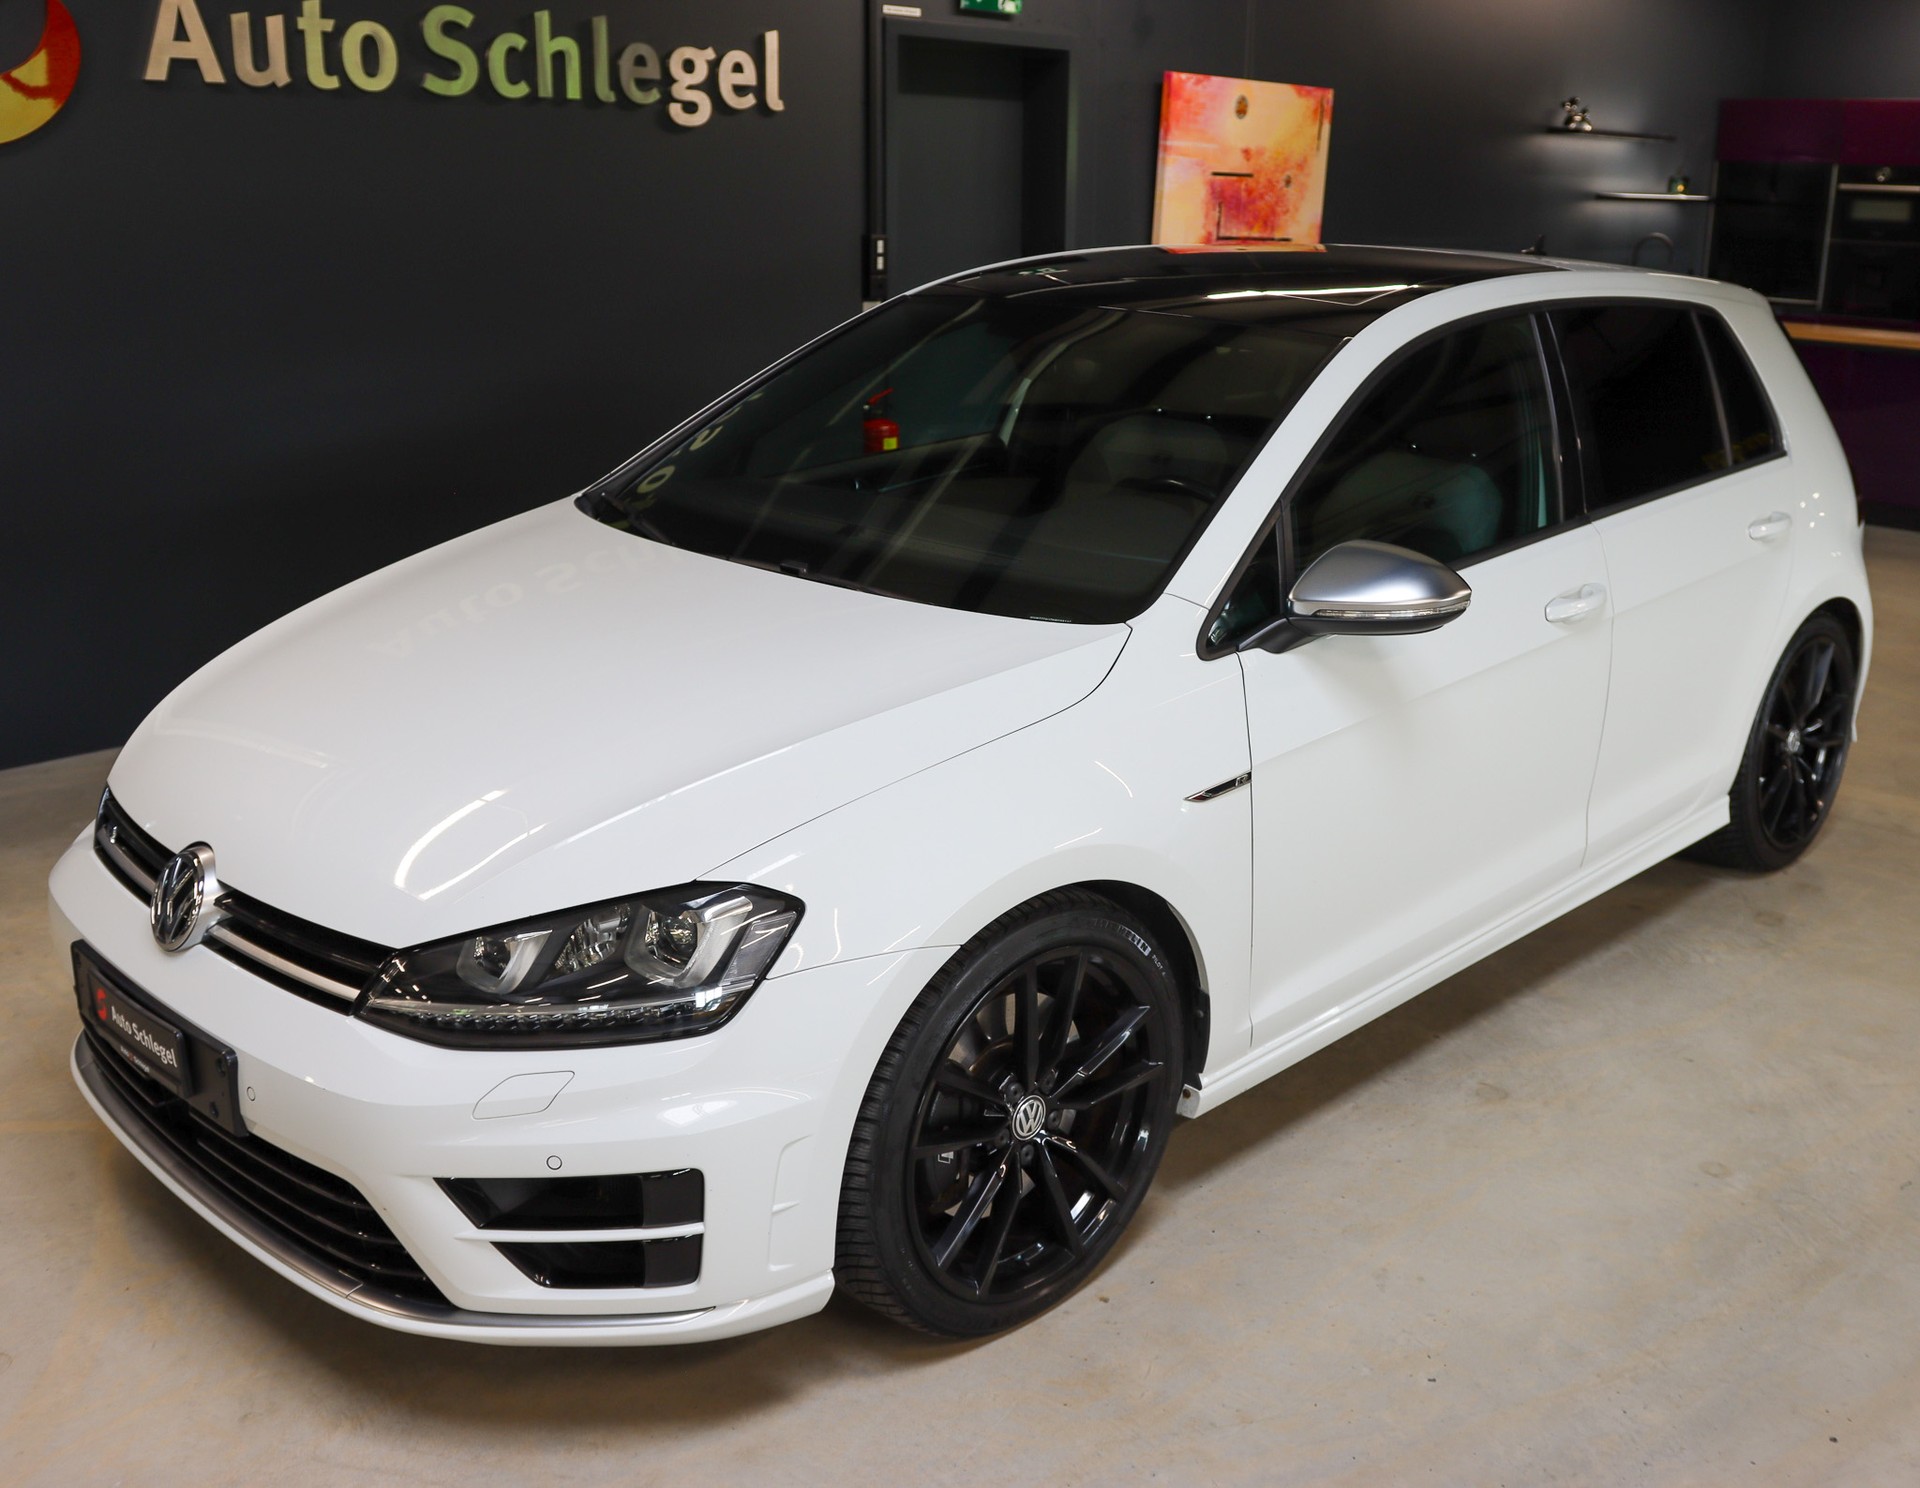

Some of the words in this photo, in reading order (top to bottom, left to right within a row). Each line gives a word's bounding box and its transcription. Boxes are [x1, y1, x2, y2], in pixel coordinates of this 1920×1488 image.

[144, 0, 399, 92] Auto
[422, 4, 785, 127] Schlegel
[111, 1005, 132, 1035] Auto
[132, 1022, 178, 1068] Schlegel
